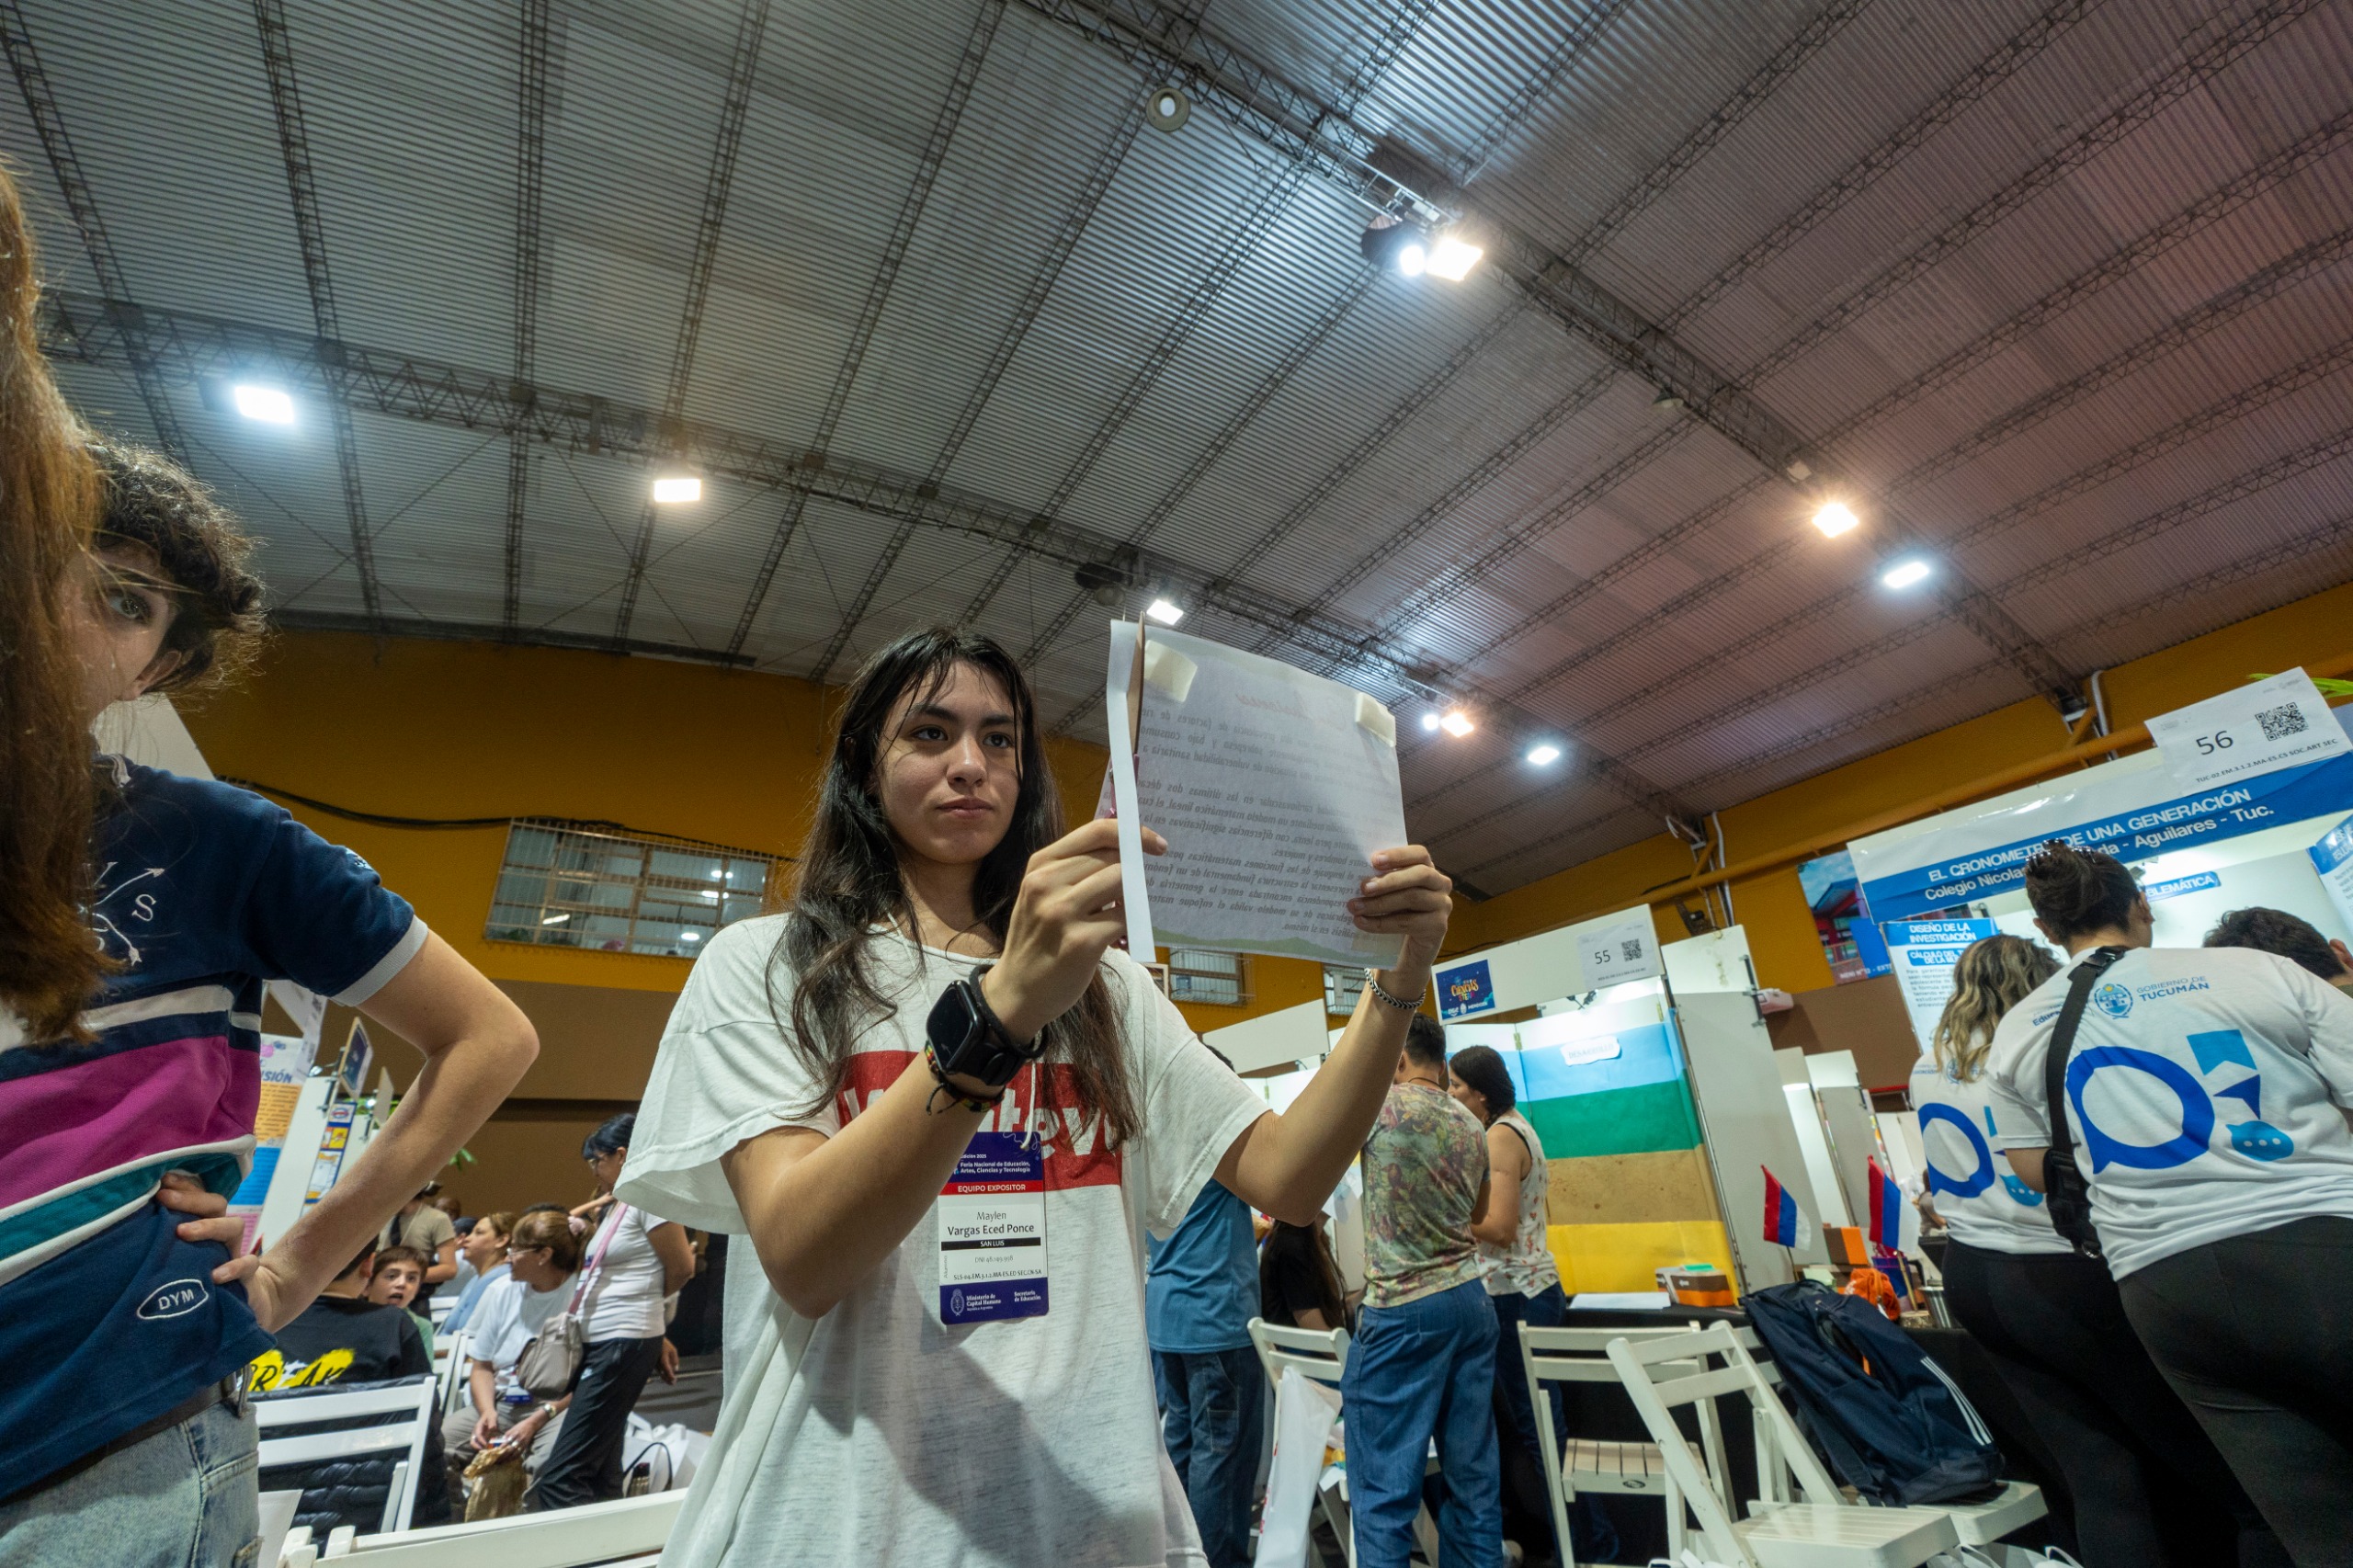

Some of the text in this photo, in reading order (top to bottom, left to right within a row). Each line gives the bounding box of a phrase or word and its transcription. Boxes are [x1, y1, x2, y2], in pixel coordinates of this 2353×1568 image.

[2196, 731, 2234, 755] 56
[2289, 744, 2321, 756] SOC.ART
[1928, 789, 2252, 881] EL CRONOMETR DE UNA GENERACIÓN
[1925, 881, 1976, 900] Colegio
[2134, 818, 2217, 848] Aguilares
[2229, 803, 2275, 824] Tuc.
[2146, 875, 2214, 897] BLEMÁTICA
[1909, 922, 1971, 933] DISEÑO DE LA
[1910, 931, 1977, 943] INVESTIGACIÓN
[1595, 950, 1611, 965] 55
[2137, 978, 2188, 994] GOBIERNO
[2140, 982, 2210, 1002] TUCUMÁN
[261, 1069, 293, 1084] SIÓN
[976, 1210, 1006, 1222] Maylen
[948, 1223, 1035, 1238] Vargas Eced Ponce
[158, 1289, 194, 1311] DYM
